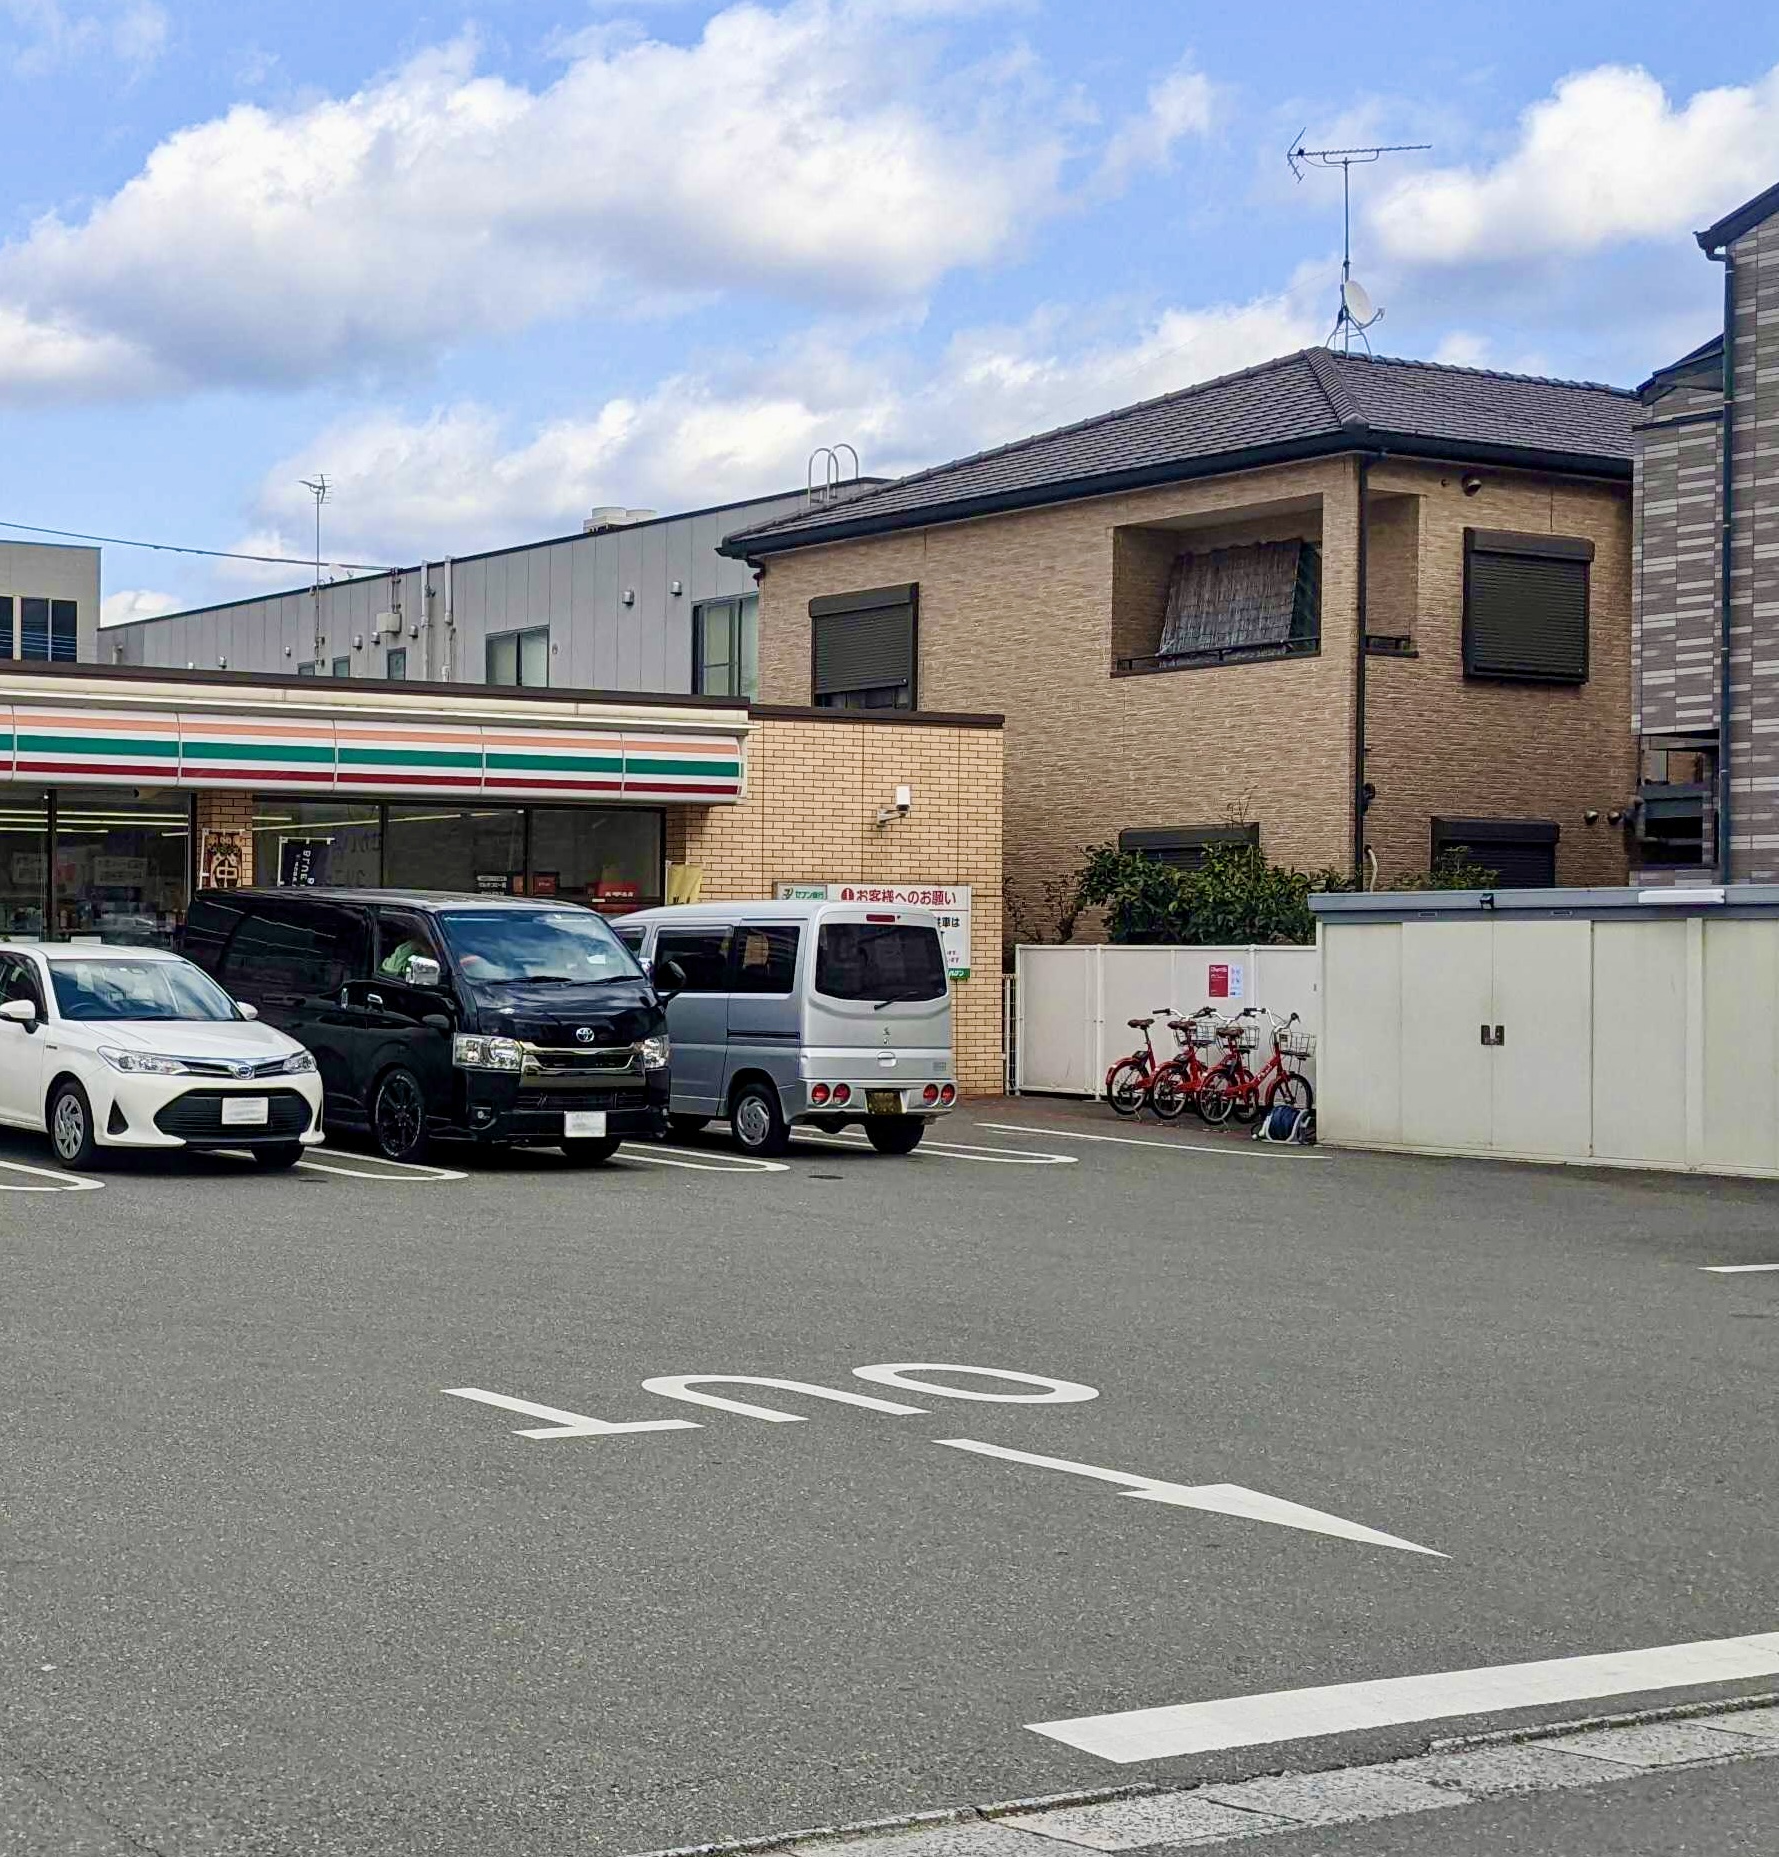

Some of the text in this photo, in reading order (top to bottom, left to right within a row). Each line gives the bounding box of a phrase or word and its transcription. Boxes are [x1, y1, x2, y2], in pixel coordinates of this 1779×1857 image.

[856, 889, 957, 906] お客様へのお願い
[440, 1363, 1099, 1440] OUT
